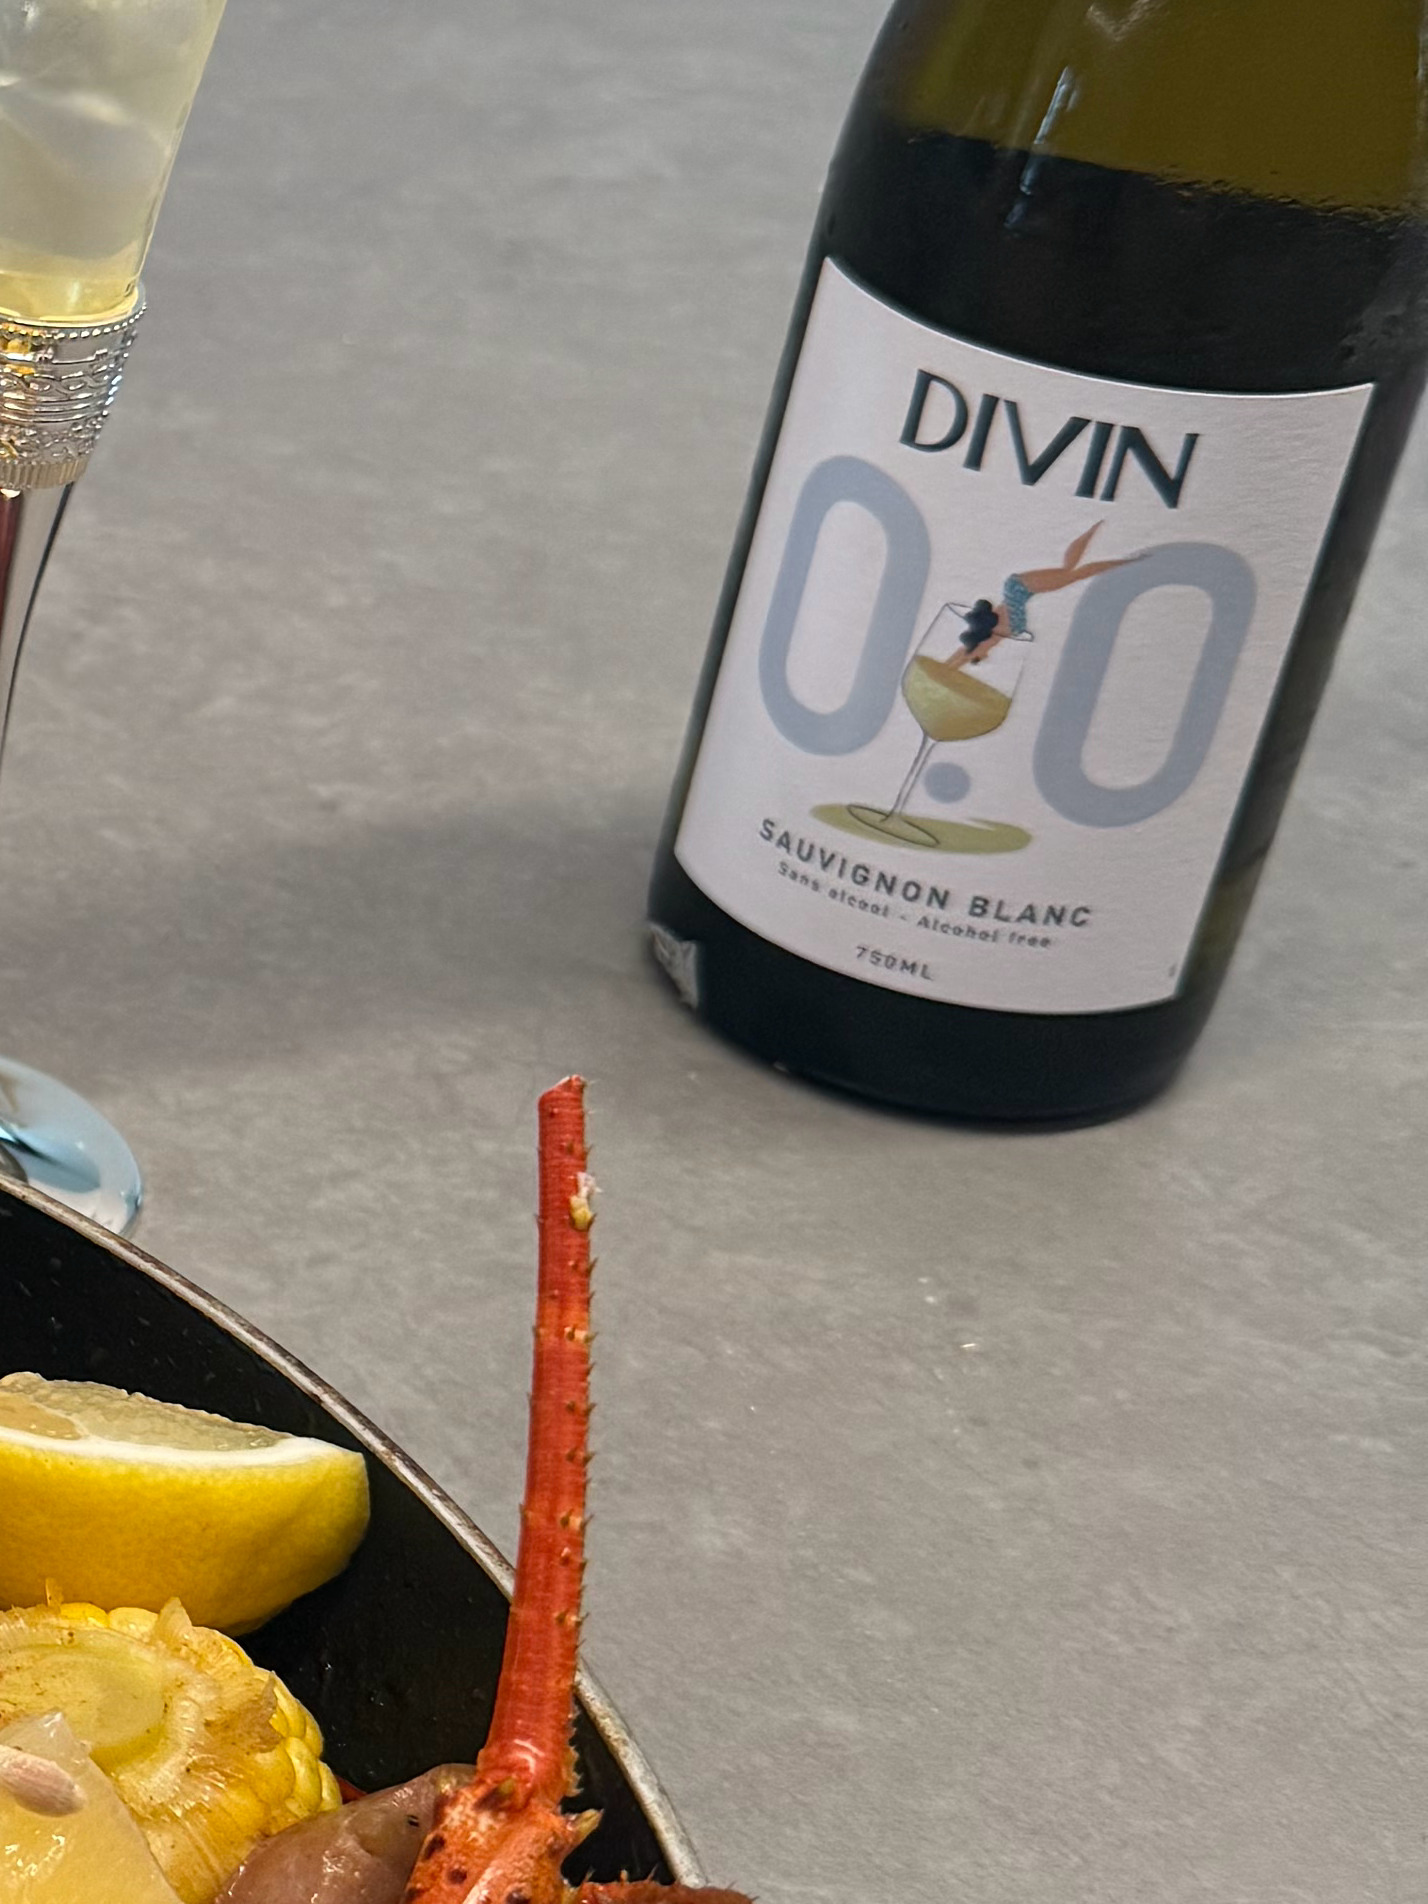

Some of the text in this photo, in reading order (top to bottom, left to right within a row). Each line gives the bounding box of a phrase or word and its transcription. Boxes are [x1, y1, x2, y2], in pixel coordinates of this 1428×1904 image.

[899, 368, 1204, 509] DIVIN
[758, 817, 1092, 928] SAUVIGNON BLANC
[778, 861, 821, 892] Sans
[916, 914, 999, 944] Alcohol
[854, 945, 934, 981] 750ML
